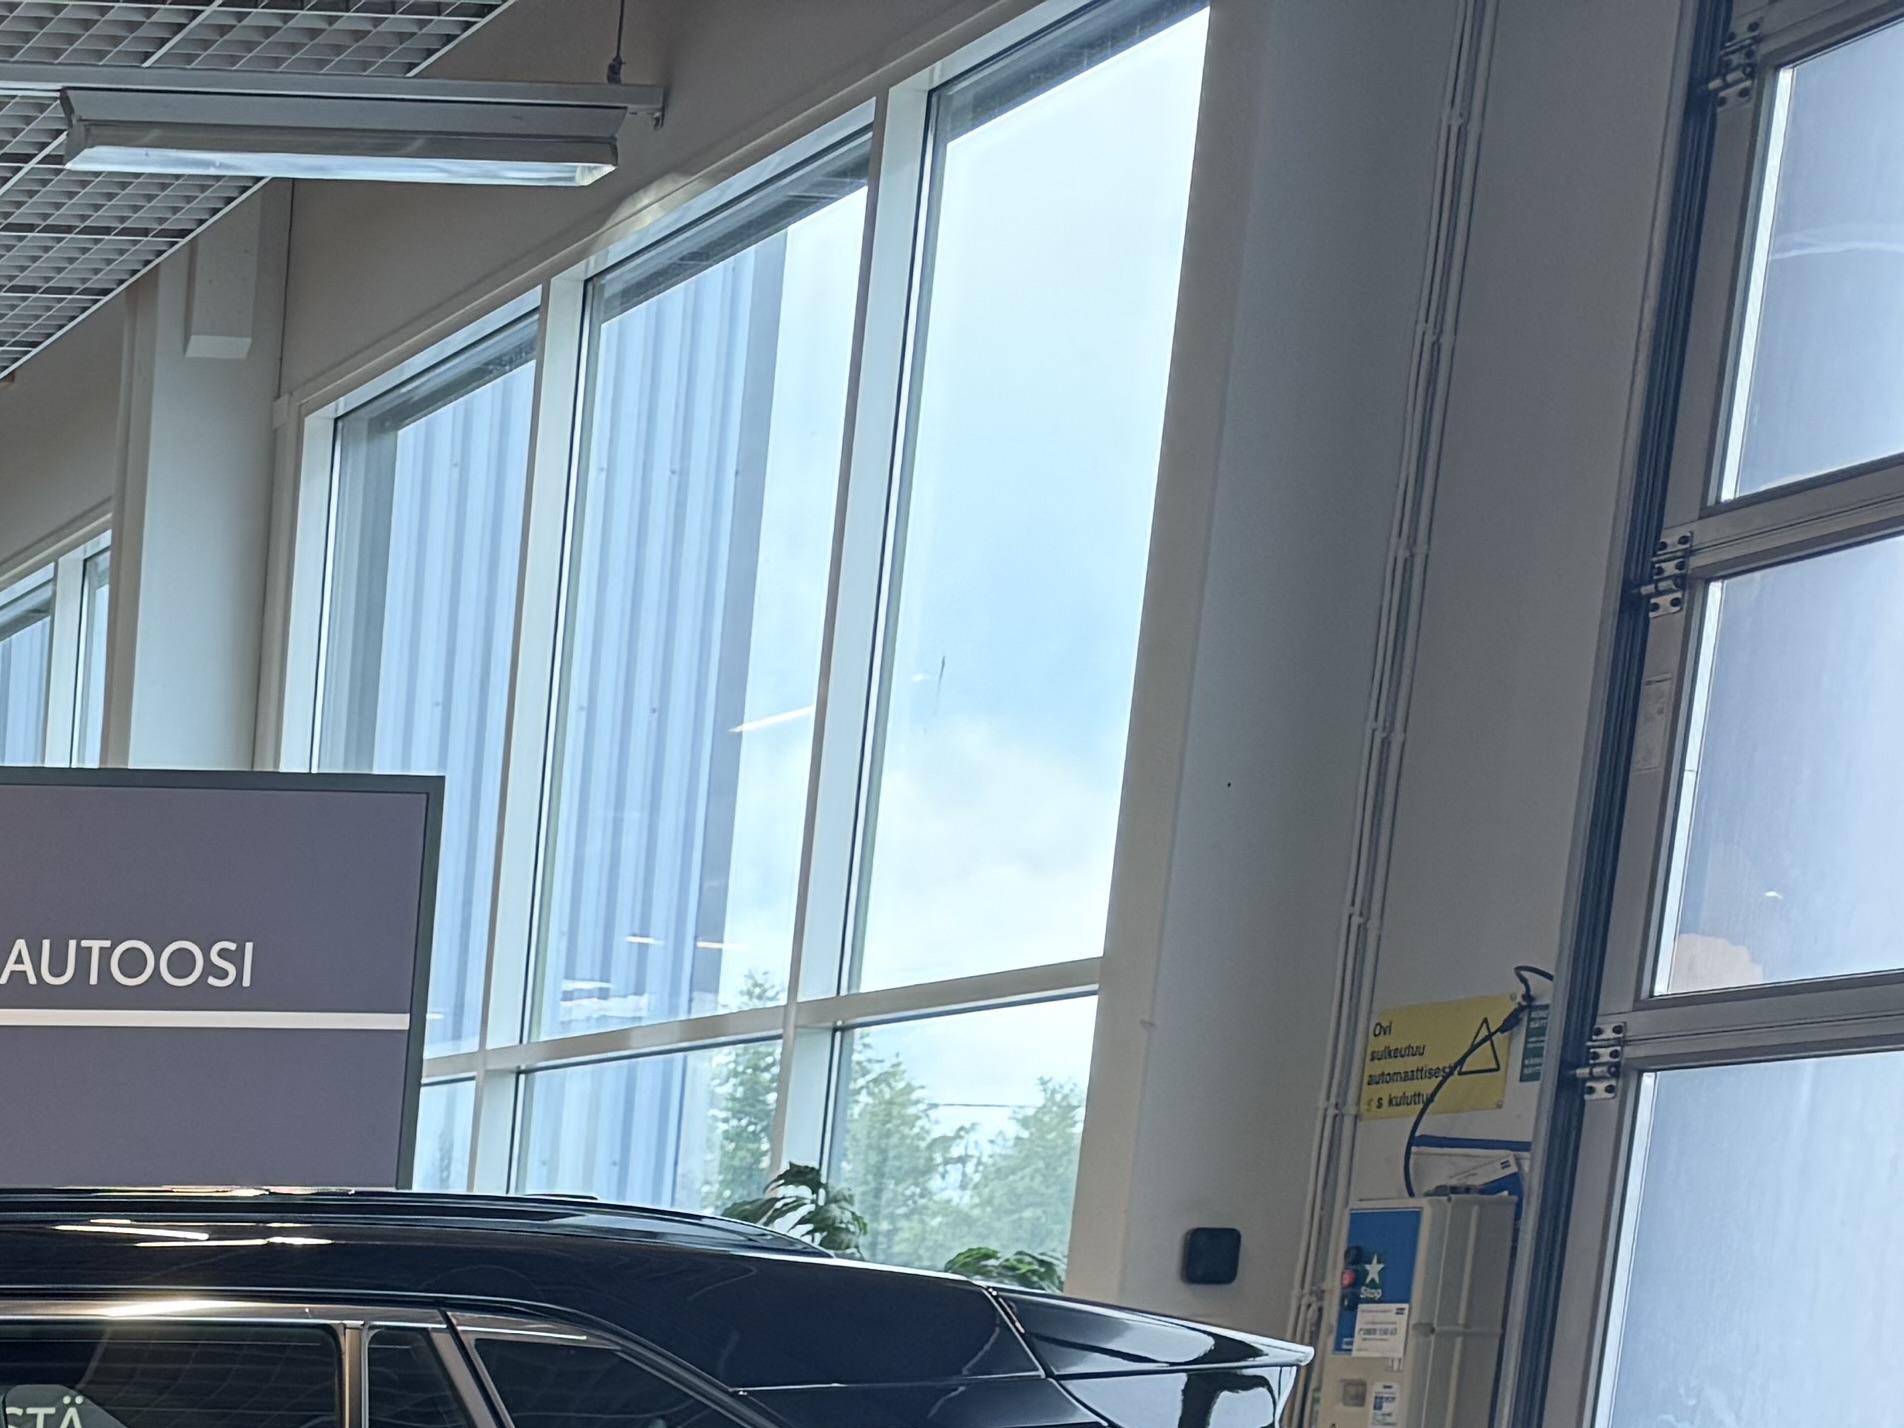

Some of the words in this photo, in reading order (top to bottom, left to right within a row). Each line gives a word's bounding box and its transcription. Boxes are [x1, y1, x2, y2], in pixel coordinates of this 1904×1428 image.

[0, 938, 254, 988] AUTOOSI
[1373, 1021, 1392, 1038] Ovi
[1370, 1044, 1425, 1062] sulkeutuu
[1388, 1092, 1432, 1108] kuluttu
[1360, 1286, 1382, 1301] Stop
